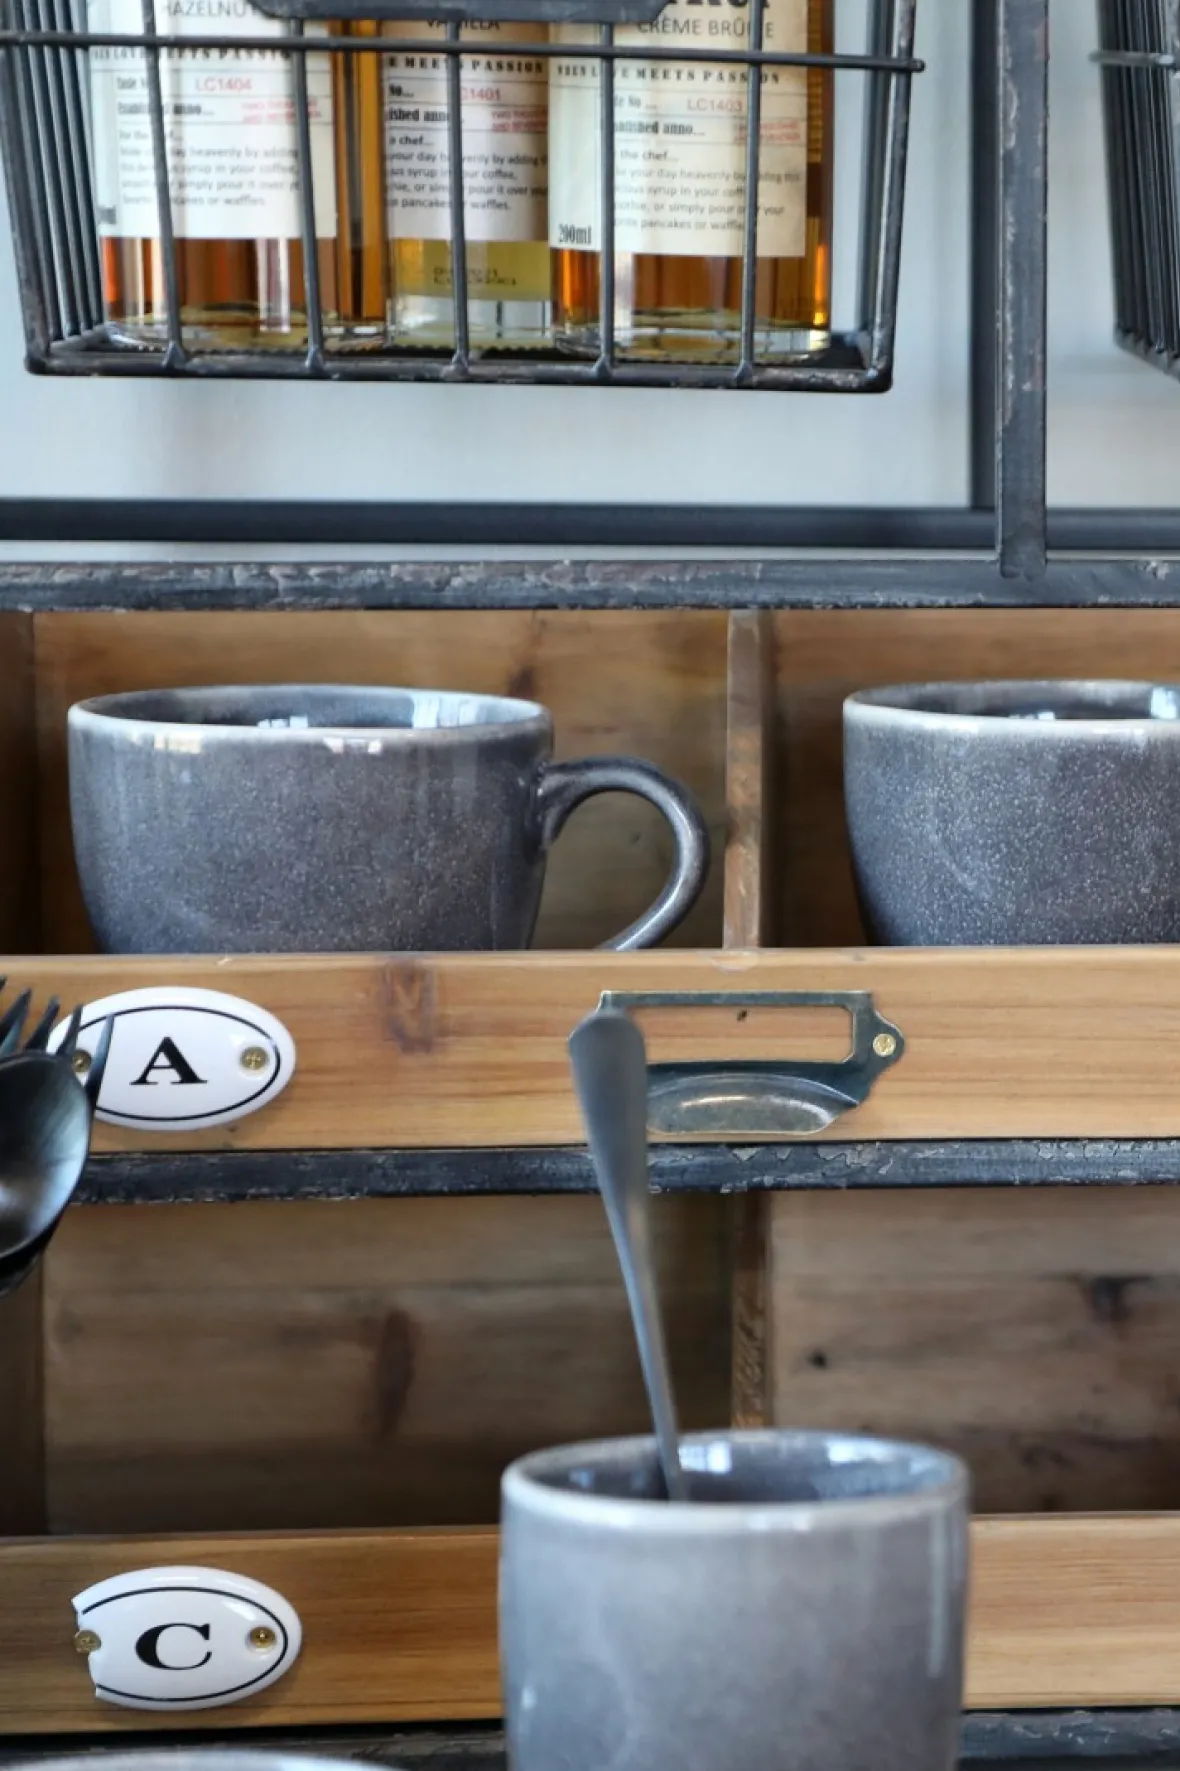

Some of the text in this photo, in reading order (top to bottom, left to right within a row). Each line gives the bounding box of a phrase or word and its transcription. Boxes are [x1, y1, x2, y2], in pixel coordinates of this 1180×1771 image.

[163, 0, 258, 18] HAZELNU
[708, 17, 774, 38] BRÛE
[471, 59, 544, 74] PASSION
[195, 78, 252, 92] LC1404
[636, 68, 696, 82] MEETS
[703, 71, 780, 84] PASSON
[687, 100, 743, 113] LC1403
[557, 223, 593, 246] 200ml
[129, 1036, 208, 1086] A
[135, 1622, 212, 1671] C
